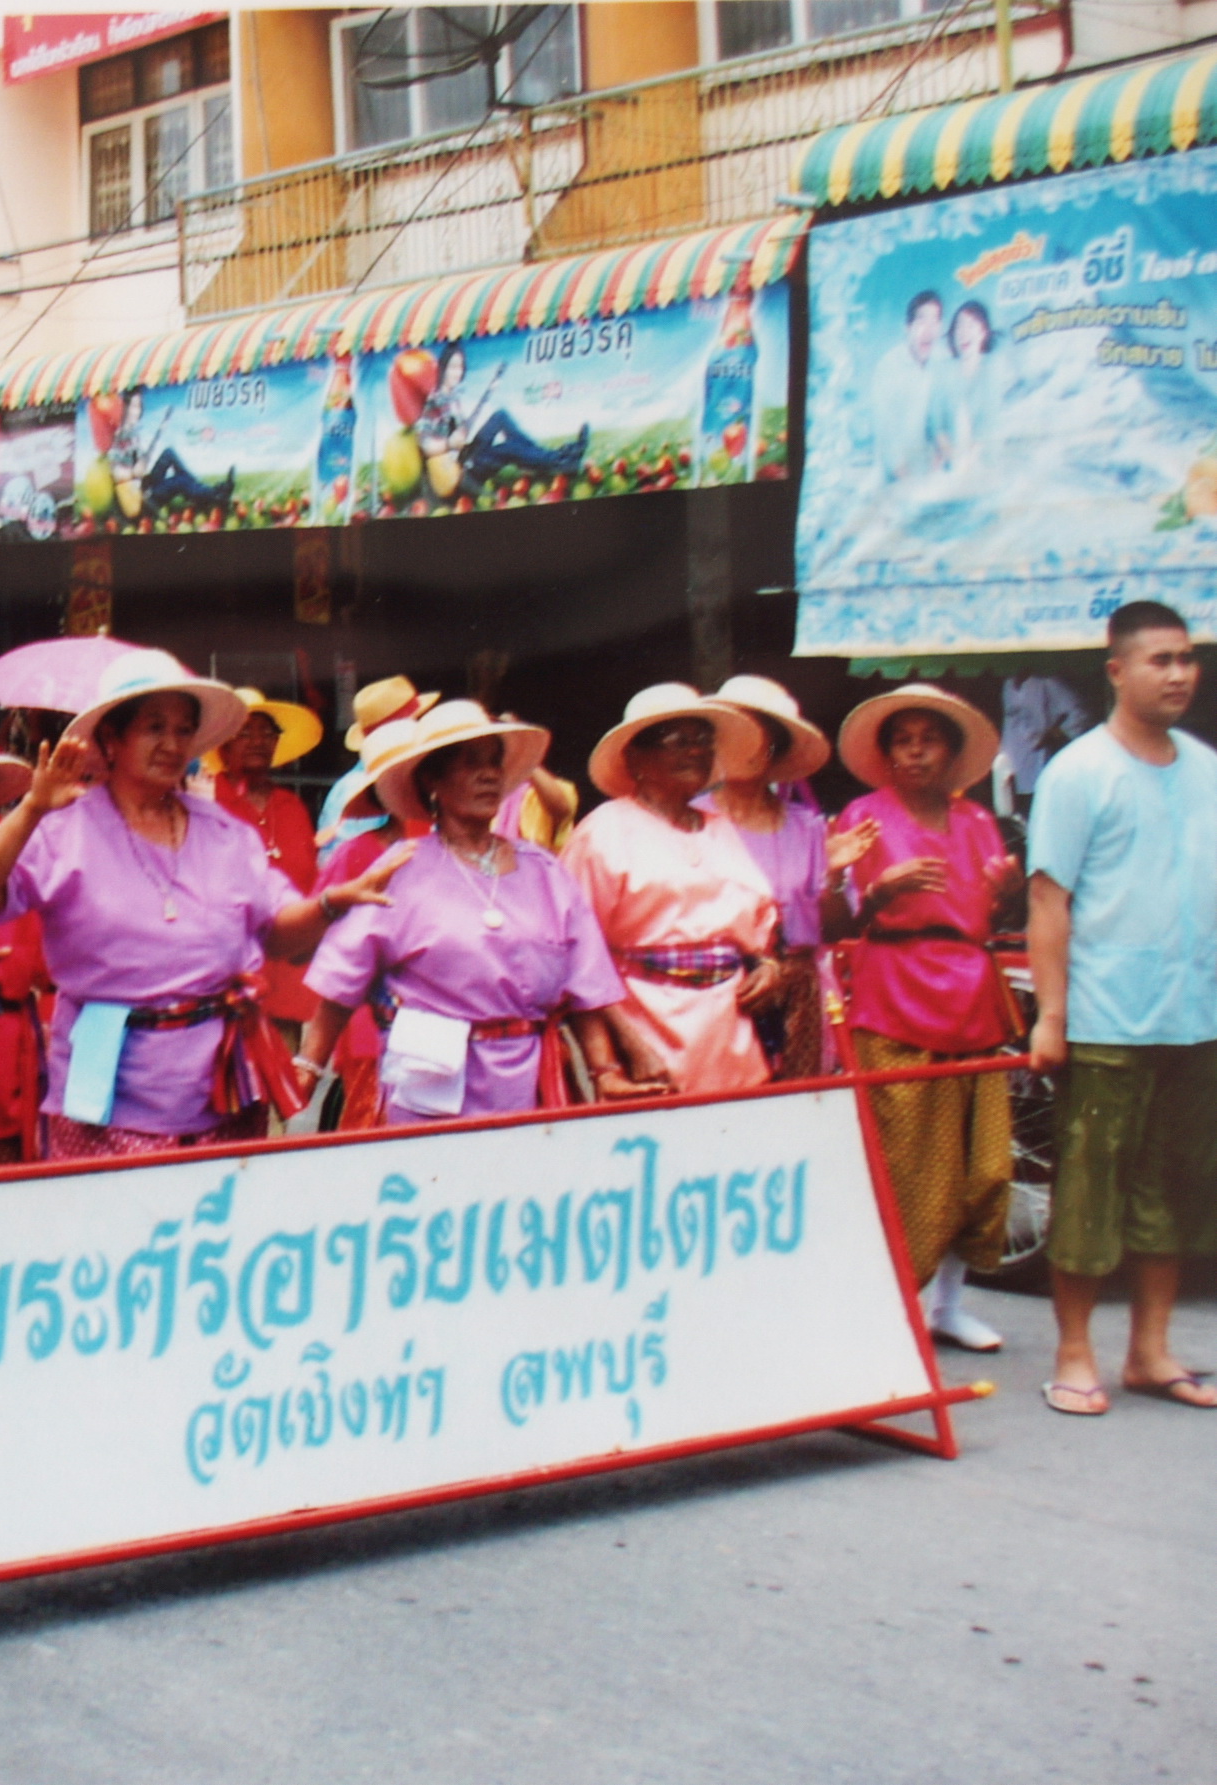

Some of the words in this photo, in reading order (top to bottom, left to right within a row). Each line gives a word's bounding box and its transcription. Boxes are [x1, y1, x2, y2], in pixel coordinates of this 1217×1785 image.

[185, 1339, 446, 1486] วัดเชิงท่า
[500, 1290, 669, 1439] ลพบุรี
